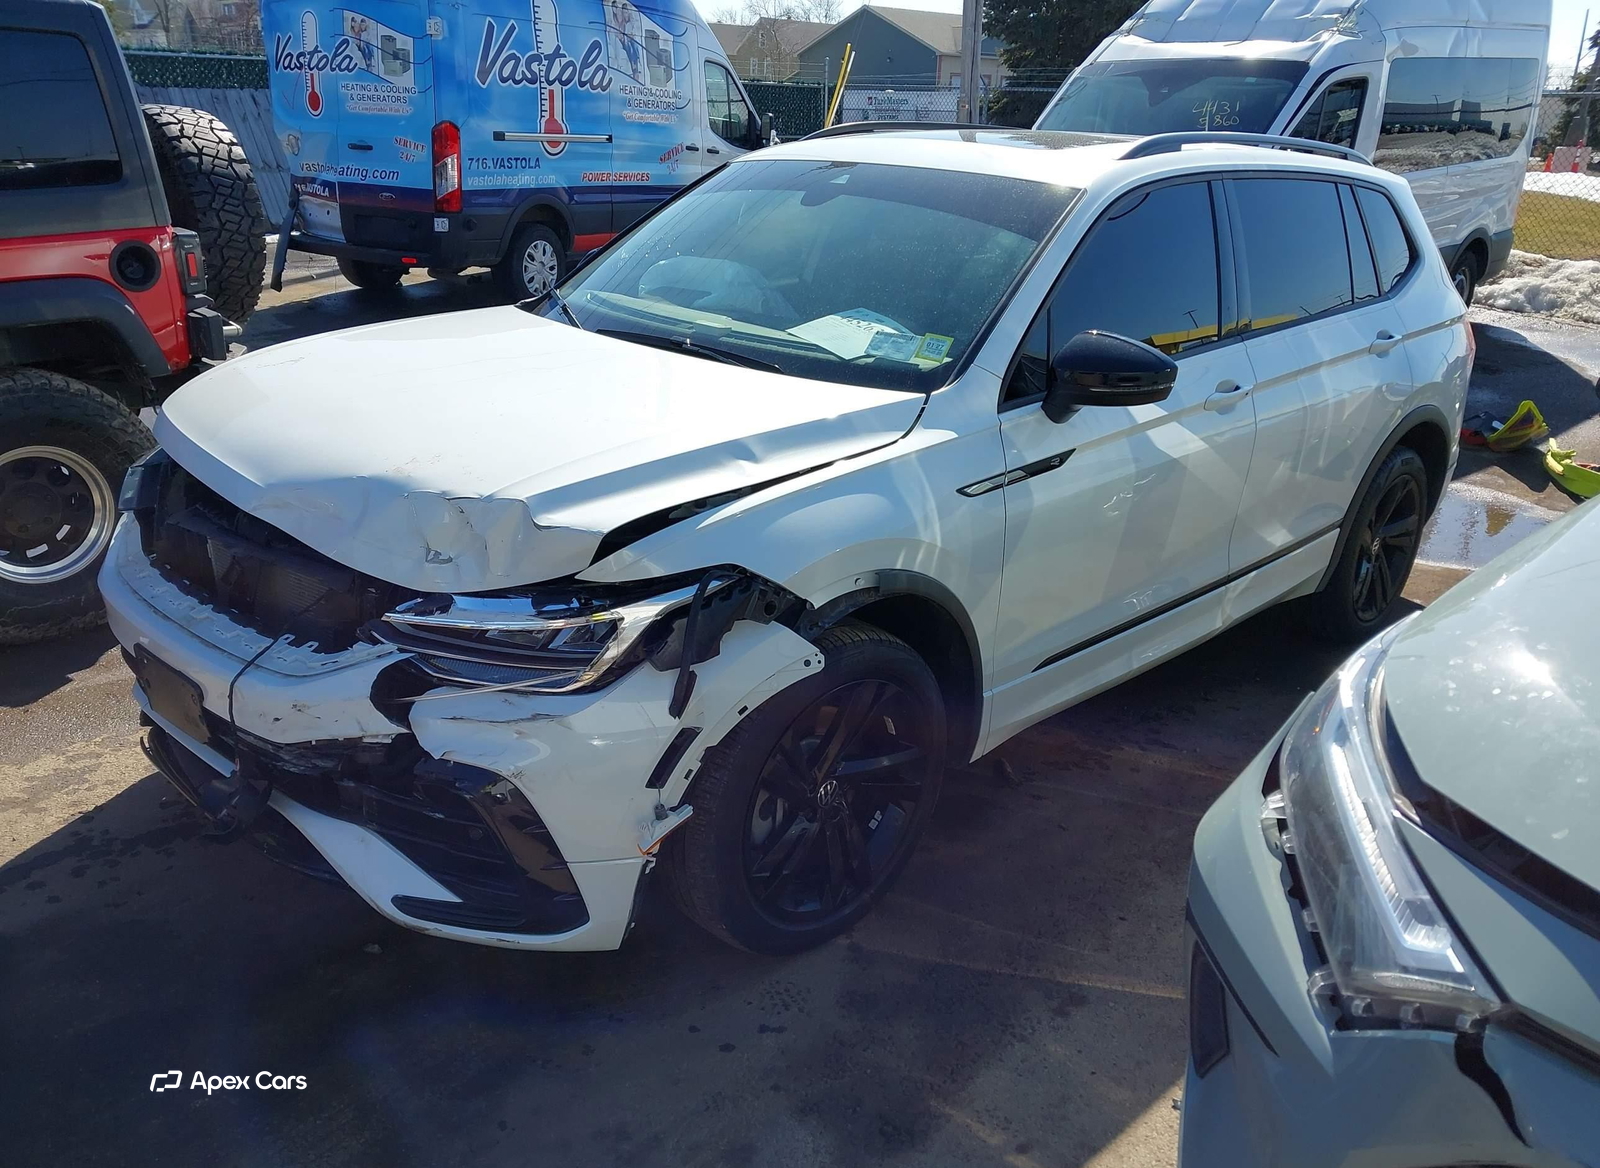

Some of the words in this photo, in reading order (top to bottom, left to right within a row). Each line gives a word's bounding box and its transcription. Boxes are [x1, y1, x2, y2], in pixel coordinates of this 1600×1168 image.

[275, 34, 358, 73] Vastola
[476, 19, 613, 92] Vastola
[340, 82, 372, 92] HEATING
[373, 84, 379, 93] &
[380, 85, 417, 95] COOLING
[619, 84, 648, 97] HEATING
[649, 87, 654, 97] &
[655, 88, 682, 100] COOLING
[349, 93, 355, 101] &
[356, 93, 408, 104] GENERATORS
[627, 97, 632, 107] &
[633, 98, 676, 111] GENERATORS
[358, 105, 387, 113] Comfortable
[1192, 99, 1240, 115] 4431
[393, 136, 427, 153] SERVICE
[399, 151, 416, 163] 24/7
[659, 141, 685, 165] SERVICE
[467, 157, 541, 170] 716.VASTOLA
[299, 161, 400, 182] vastolaheating.com
[581, 172, 612, 182] POWER
[612, 172, 651, 182] SERVICES
[467, 174, 556, 188] vastolaheating.com
